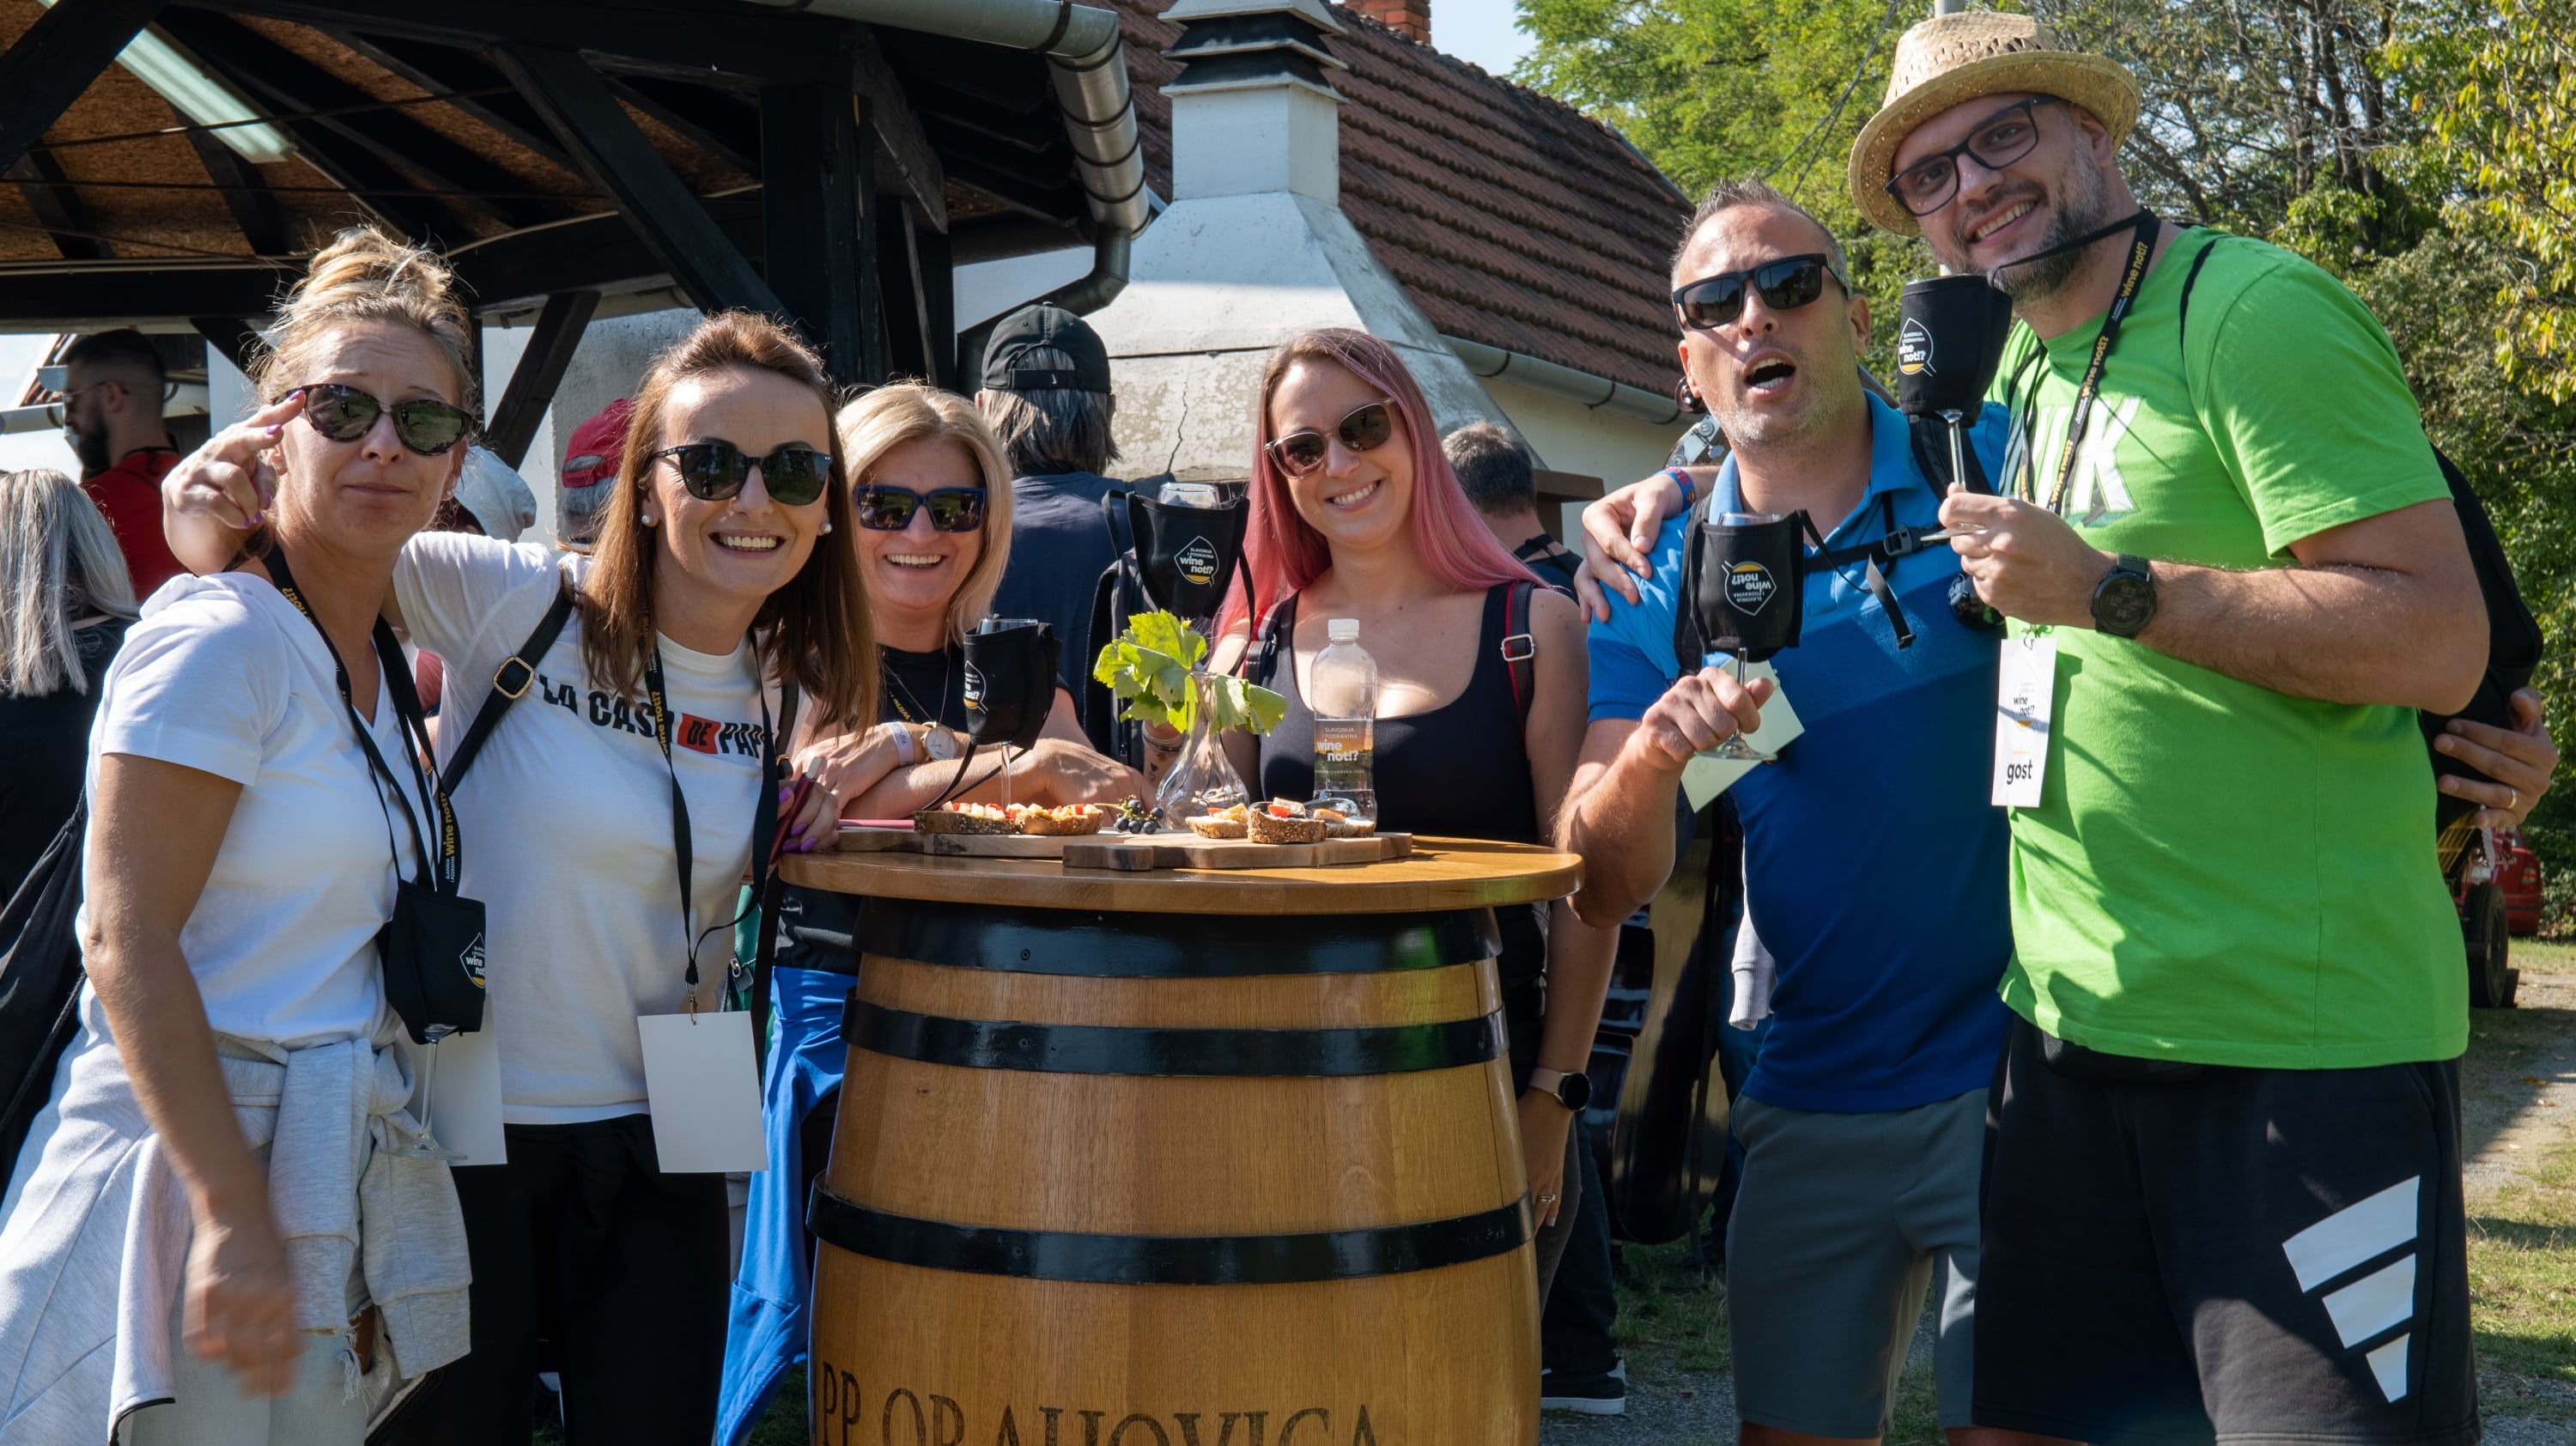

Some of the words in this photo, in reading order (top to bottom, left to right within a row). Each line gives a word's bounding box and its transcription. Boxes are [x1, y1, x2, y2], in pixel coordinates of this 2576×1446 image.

[2122, 269, 2139, 298] wine
[2132, 241, 2148, 272] not!?
[1903, 350, 1927, 362] not!?
[2081, 367, 2098, 398] wine
[2093, 336, 2109, 366] not!?
[1180, 556, 1204, 566] wine
[1191, 565, 1214, 574] not!?
[1731, 573, 1759, 586] not!?
[1745, 580, 1771, 592] wine
[2014, 694, 2028, 705] wine
[539, 674, 579, 716] LA
[687, 720, 712, 746] DE
[651, 690, 664, 723] not!?
[2020, 705, 2035, 716] not!?
[658, 724, 670, 755] wine
[1316, 738, 1343, 751] wine
[1327, 750, 1359, 762] not!?
[2007, 759, 2033, 785] gost
[440, 792, 453, 823] not!?
[443, 824, 455, 856] wine
